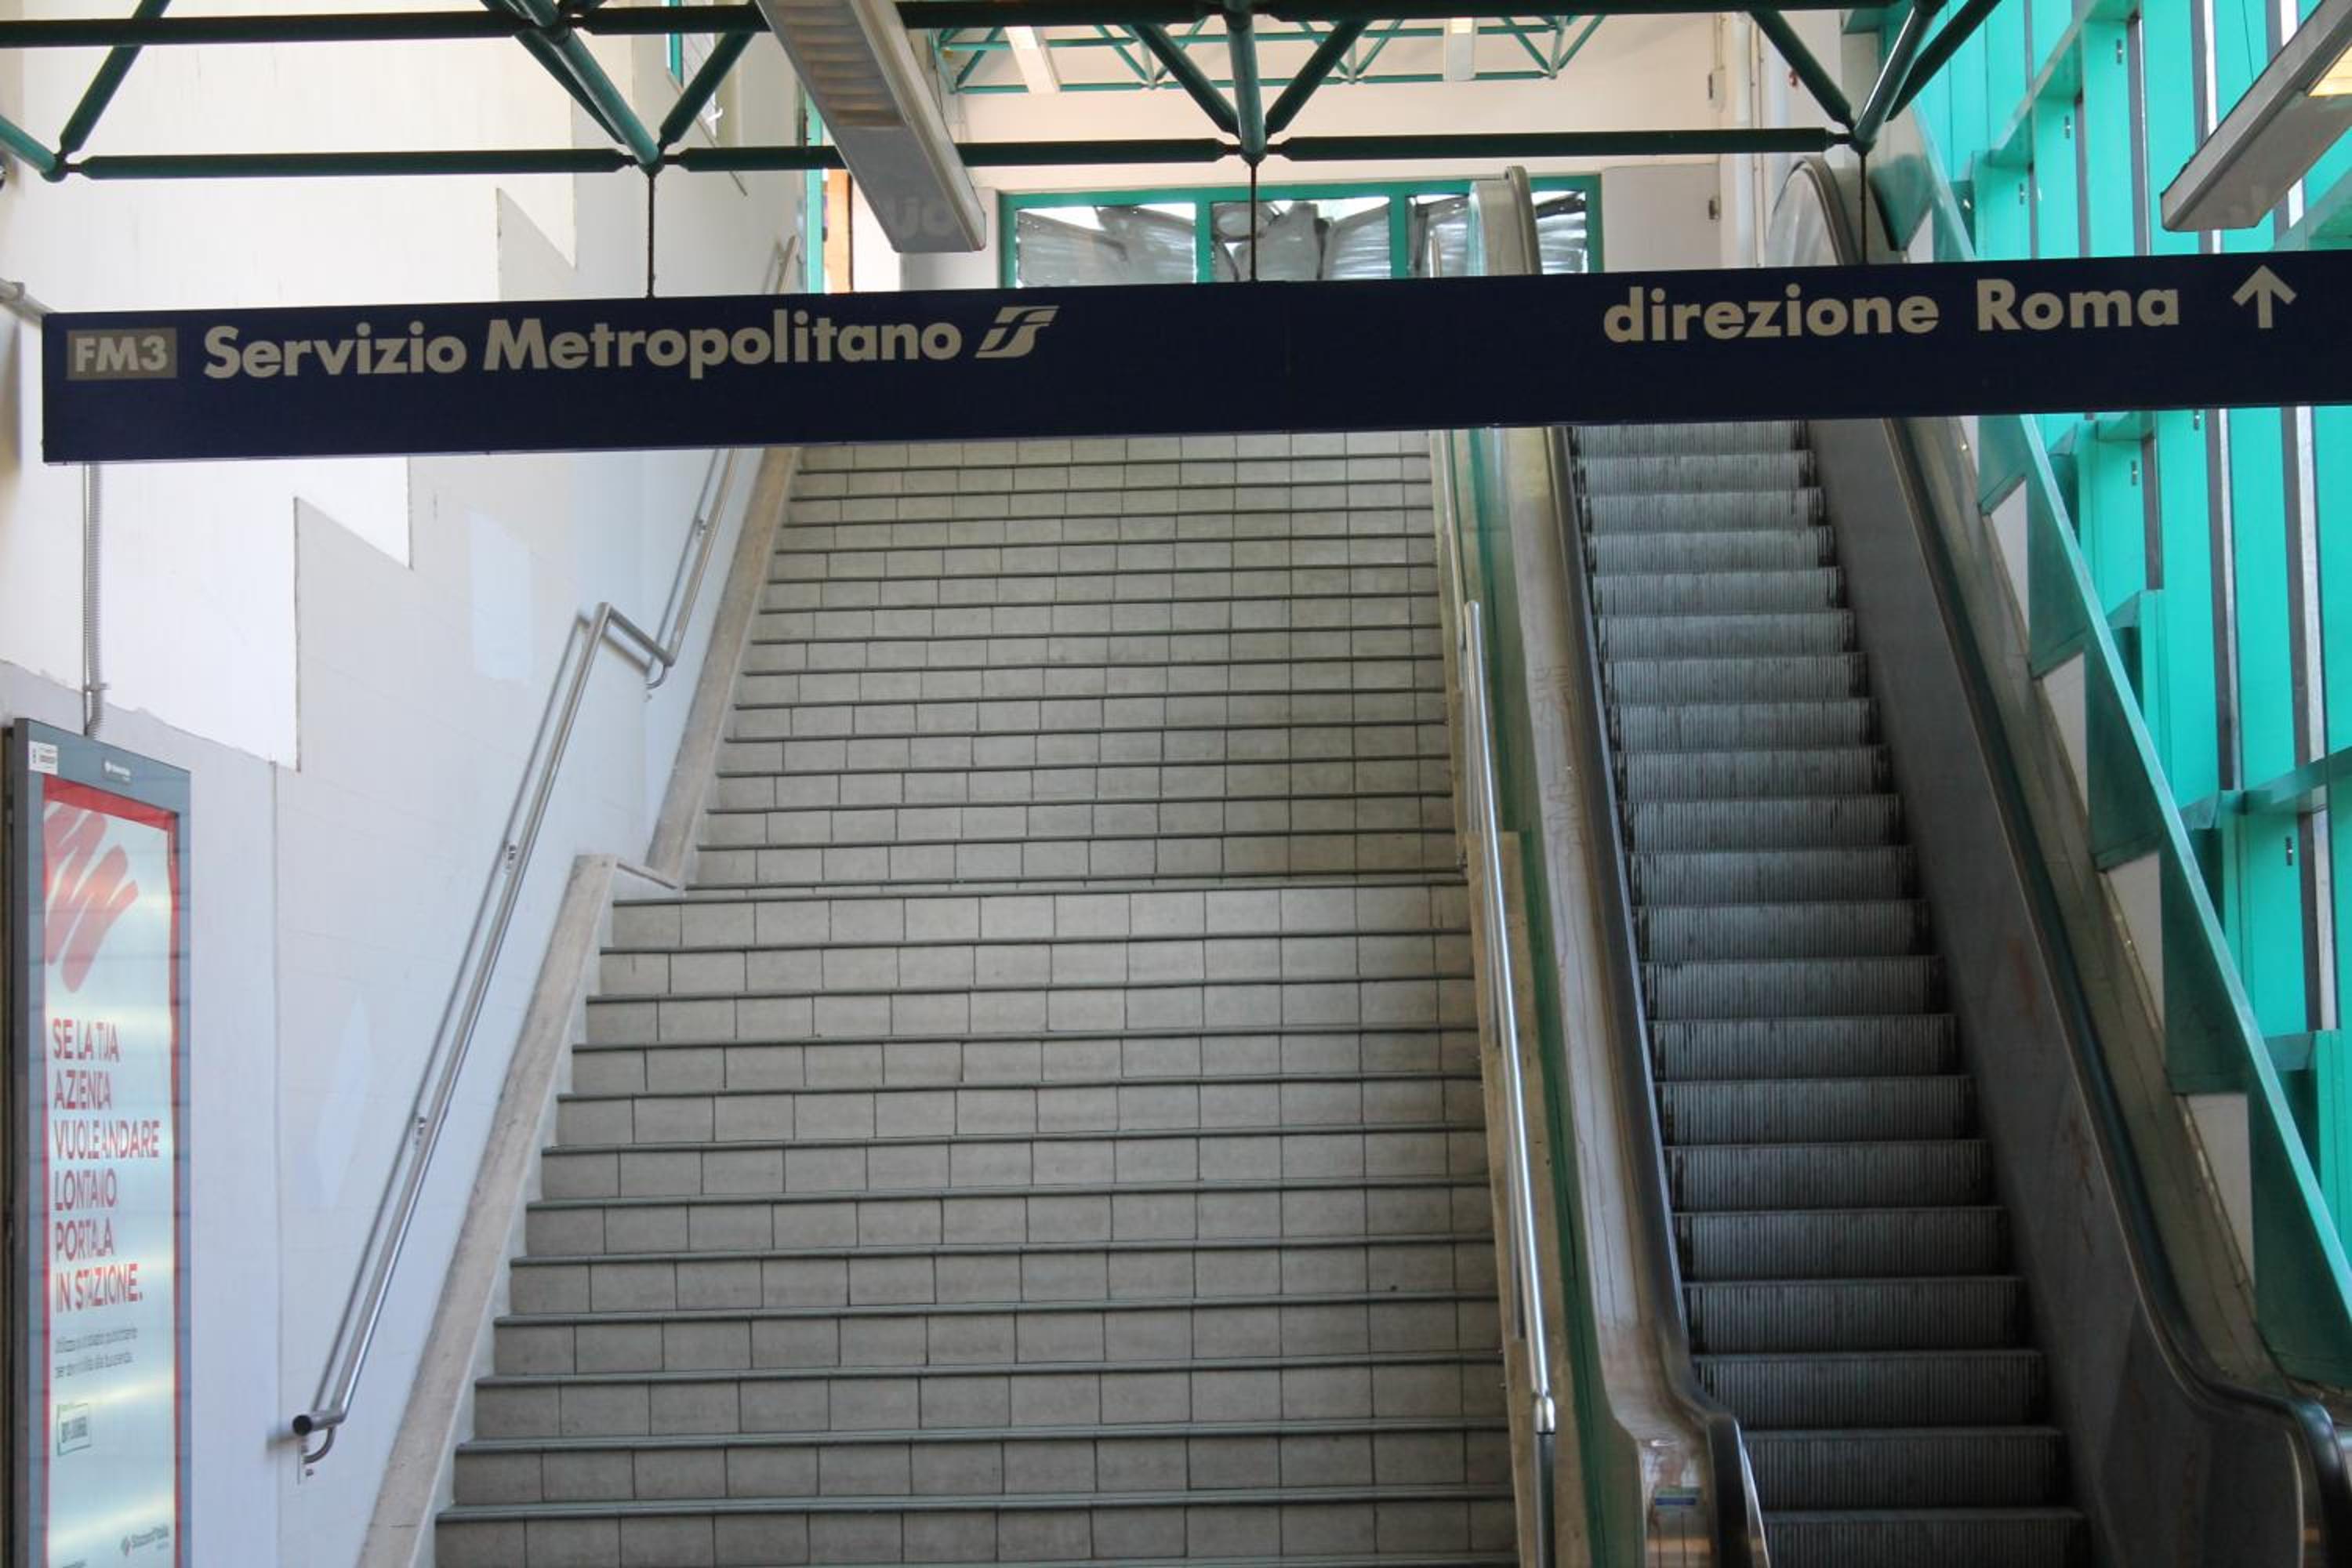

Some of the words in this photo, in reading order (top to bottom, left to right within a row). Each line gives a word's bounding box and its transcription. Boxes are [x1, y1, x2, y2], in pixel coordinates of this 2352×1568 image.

[1603, 283, 1940, 343] direzione
[1976, 278, 2180, 332] Roma
[74, 334, 169, 373] FM3
[204, 321, 467, 379] Servizio
[482, 309, 963, 379] Metropolitano
[52, 1018, 74, 1059] SE
[54, 1120, 100, 1160] VUOLE
[102, 1120, 160, 1159] ANDARE
[56, 1272, 71, 1313] IN
